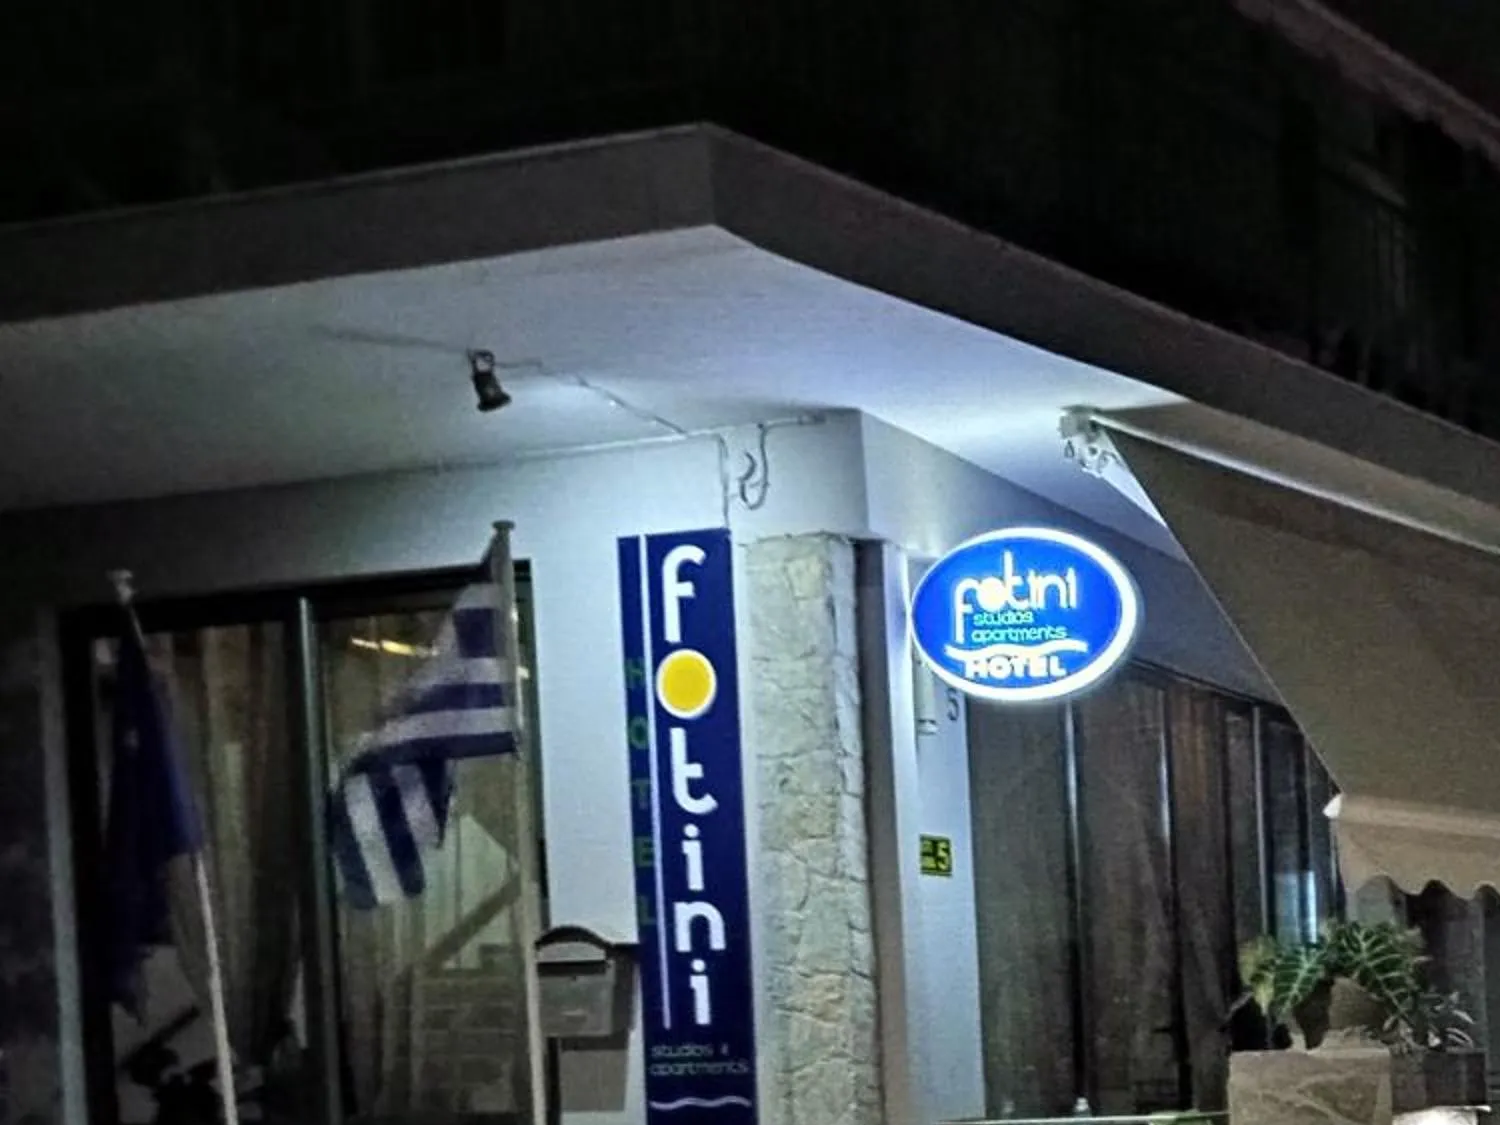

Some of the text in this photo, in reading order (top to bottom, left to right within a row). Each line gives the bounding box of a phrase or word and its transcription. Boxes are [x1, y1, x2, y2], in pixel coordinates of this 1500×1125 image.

[954, 549, 1077, 644] fotini
[973, 610, 1034, 627] studios
[971, 626, 1068, 643] apartments
[963, 655, 1067, 679] HOTEL
[625, 656, 656, 926] HOTEL
[655, 544, 727, 1026] fotini
